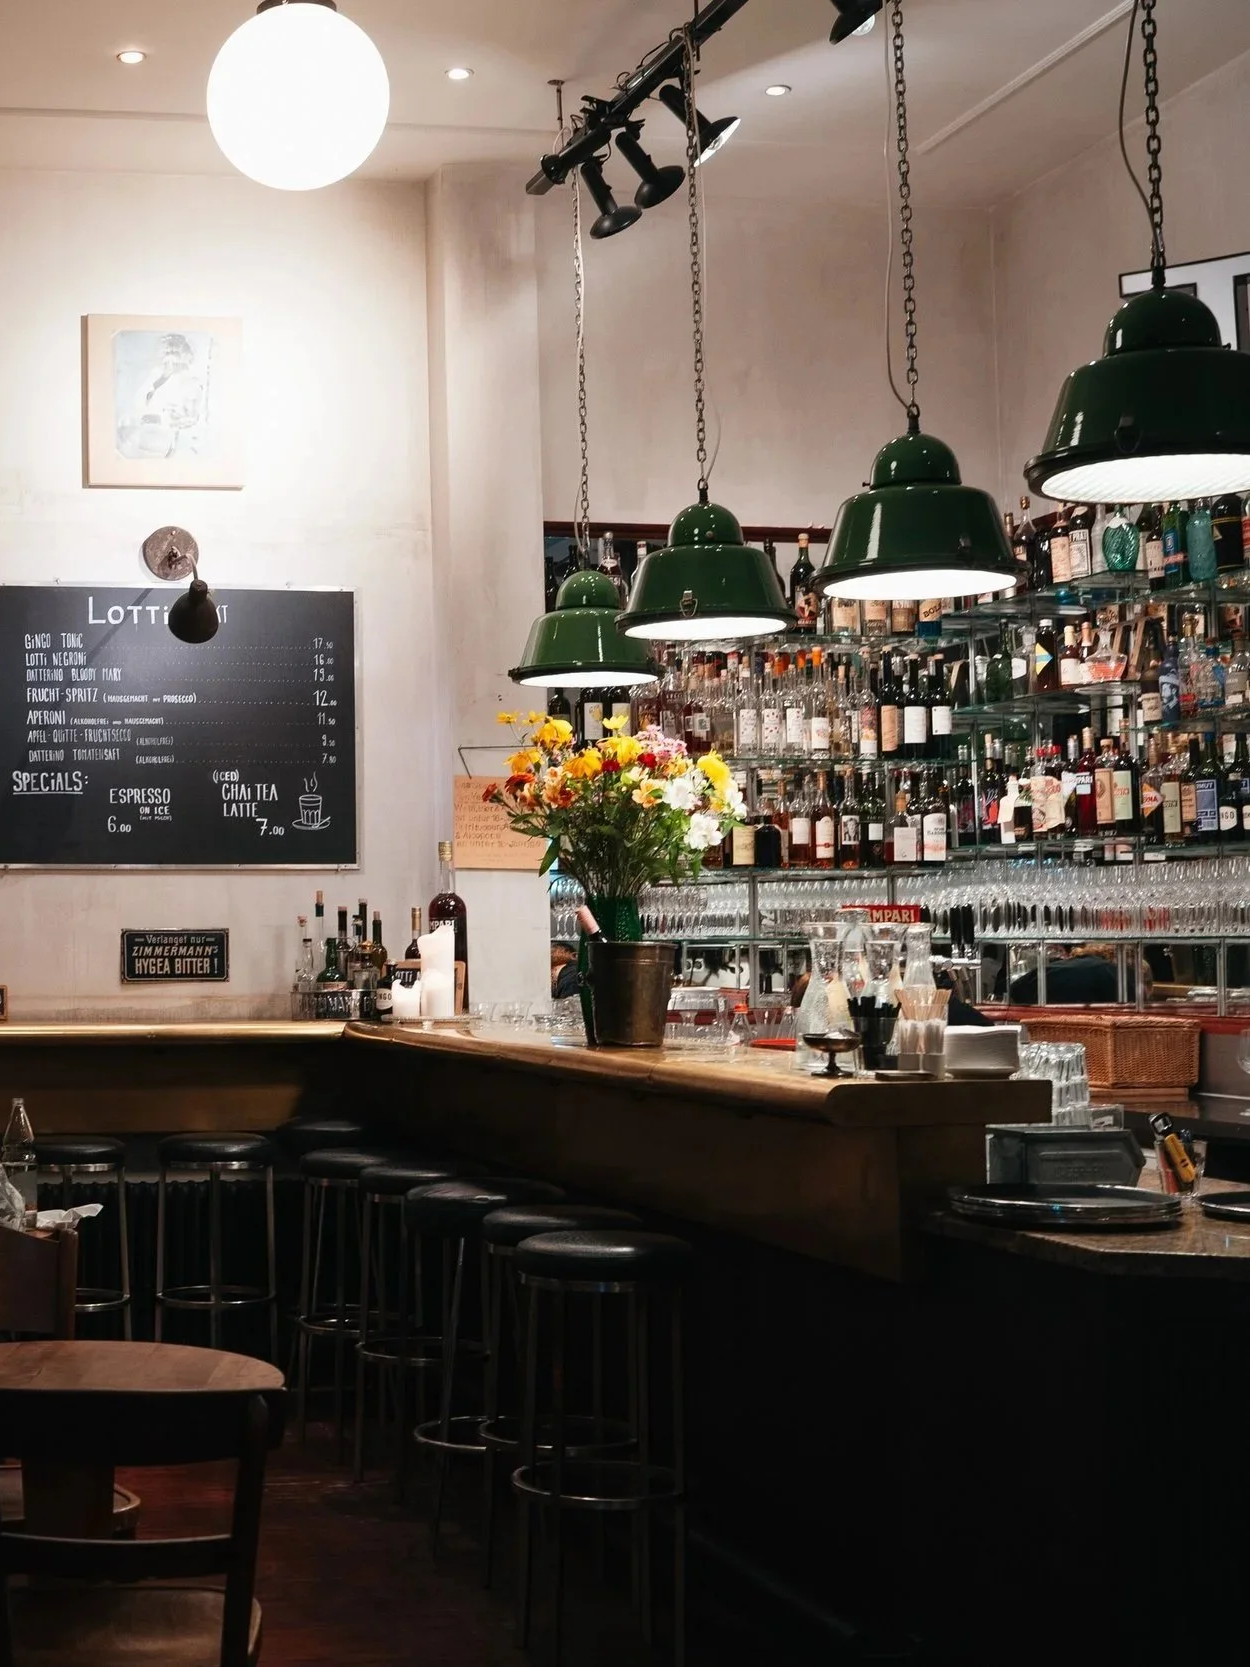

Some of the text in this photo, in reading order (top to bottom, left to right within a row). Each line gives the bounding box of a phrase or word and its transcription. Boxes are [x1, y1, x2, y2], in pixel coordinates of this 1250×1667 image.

[109, 787, 171, 804] ESPRESSO
[255, 783, 279, 801] TEA
[139, 805, 170, 815] ON ICE
[223, 802, 259, 818] LATTE
[106, 815, 132, 833] 6.00
[255, 818, 285, 836] 7.00
[135, 957, 171, 975] HYGEA
